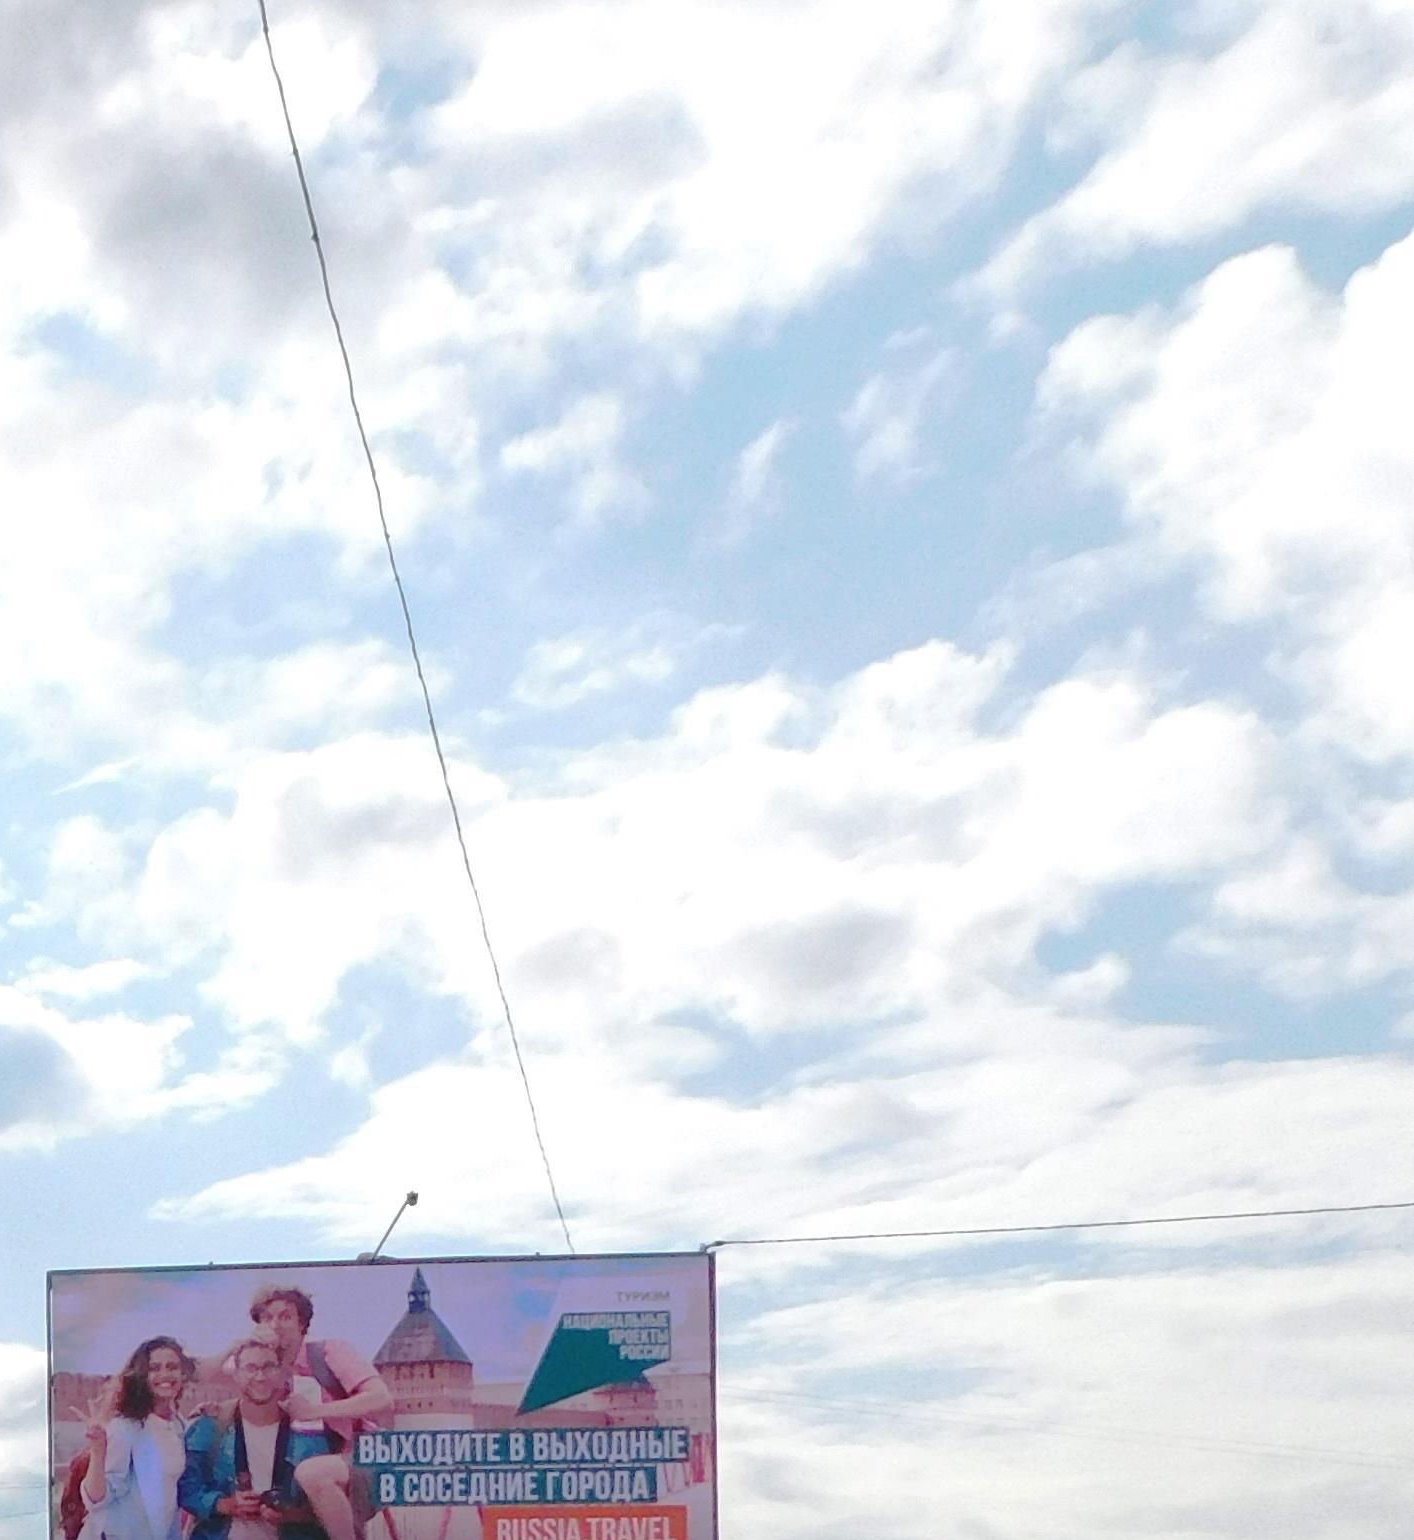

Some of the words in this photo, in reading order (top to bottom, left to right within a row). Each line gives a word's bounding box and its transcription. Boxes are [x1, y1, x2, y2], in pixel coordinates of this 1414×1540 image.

[616, 1290, 670, 1302] ТУРИЗМ
[562, 1312, 669, 1330] НАЦИОНАЛЬНЫЕ
[608, 1328, 669, 1345] ПРОЕКТЫ
[619, 1344, 669, 1360] РОССИИ
[358, 1432, 501, 1465] ВЫХОДИТЕ
[509, 1432, 523, 1462] В
[533, 1428, 688, 1463] ВЫХОДНЫЕ
[379, 1473, 396, 1503] В
[403, 1471, 539, 1505] СОСЕДНИЕ
[546, 1469, 651, 1503] ГОРОДА
